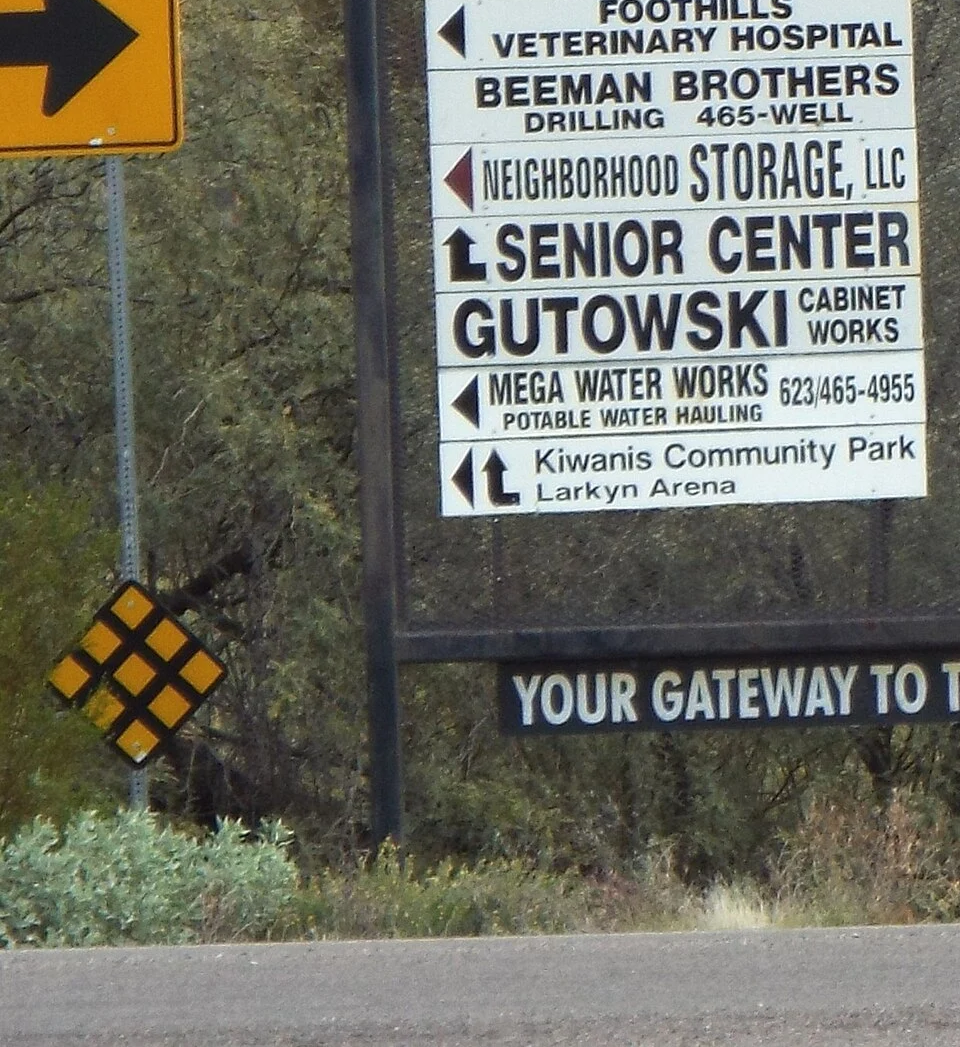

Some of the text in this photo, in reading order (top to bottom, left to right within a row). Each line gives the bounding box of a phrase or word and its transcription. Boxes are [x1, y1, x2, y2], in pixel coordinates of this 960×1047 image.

[493, 23, 902, 57] VETERINARY HOSPITAL
[476, 64, 899, 108] BEEMAN BROTHERS
[525, 103, 853, 133] DRILLING 465-WELL
[483, 140, 905, 203] NEIGHBORHOOD STORAGE, LLC
[497, 212, 910, 282] SENIOR CENTER
[800, 284, 905, 313] CABINET
[454, 290, 786, 359] GUTOWSKI
[808, 318, 898, 345] WORKS
[490, 364, 914, 407] MEGA WATER WORKS 623/465-4955
[504, 405, 762, 430] POTABLE WATER HAULING
[535, 436, 916, 474] Kiwanis Community Park
[538, 478, 735, 503] Larkyn Arena
[513, 674, 637, 725] YOUR
[652, 665, 855, 721] GATEWAY
[870, 664, 928, 715] TO
